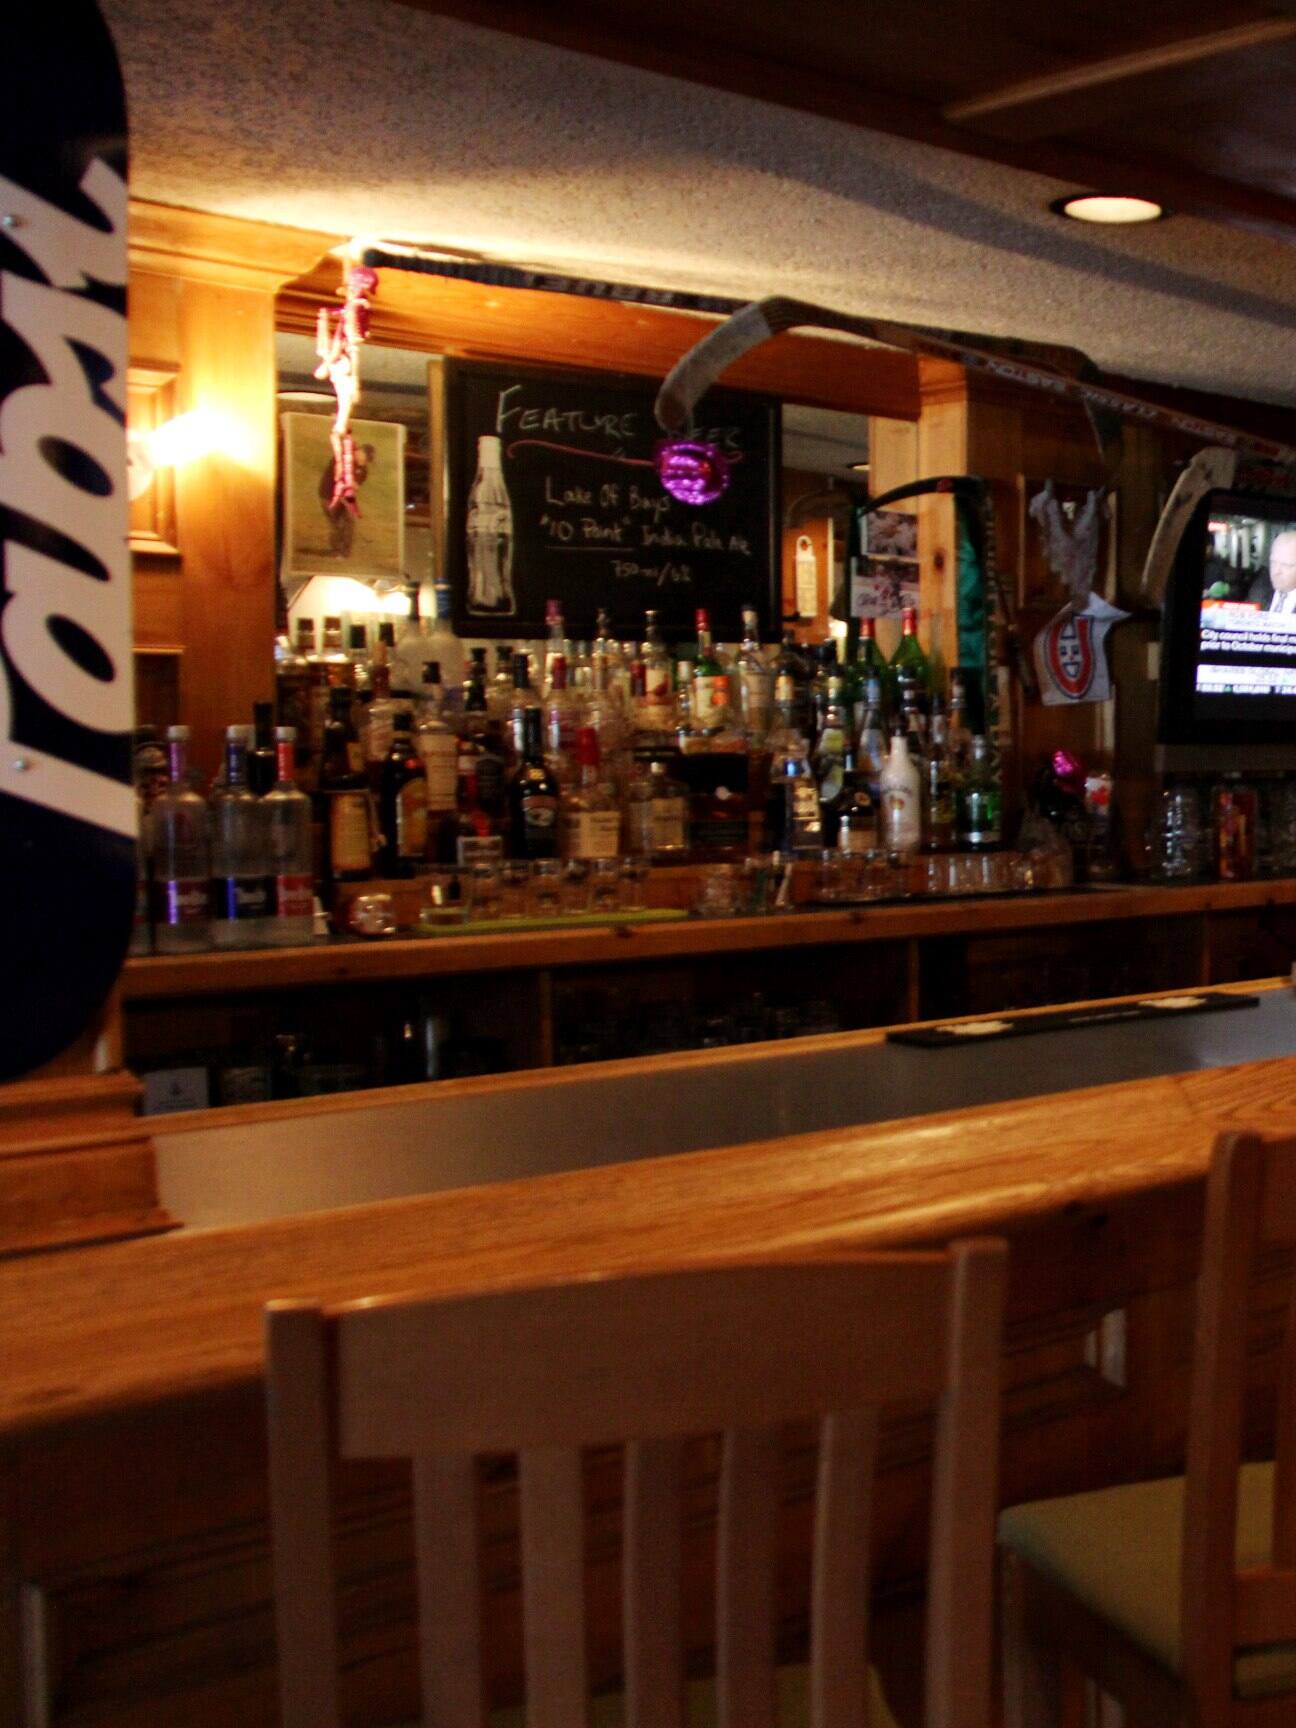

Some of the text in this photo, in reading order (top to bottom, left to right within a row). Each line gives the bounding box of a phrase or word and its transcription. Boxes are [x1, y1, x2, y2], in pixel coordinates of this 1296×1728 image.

[496, 384, 638, 437] FEATURE
[1201, 629, 1219, 642] City
[1219, 631, 1248, 642] council
[1200, 640, 1221, 651] prior
[1221, 641, 1231, 651] to
[1231, 641, 1263, 653] October
